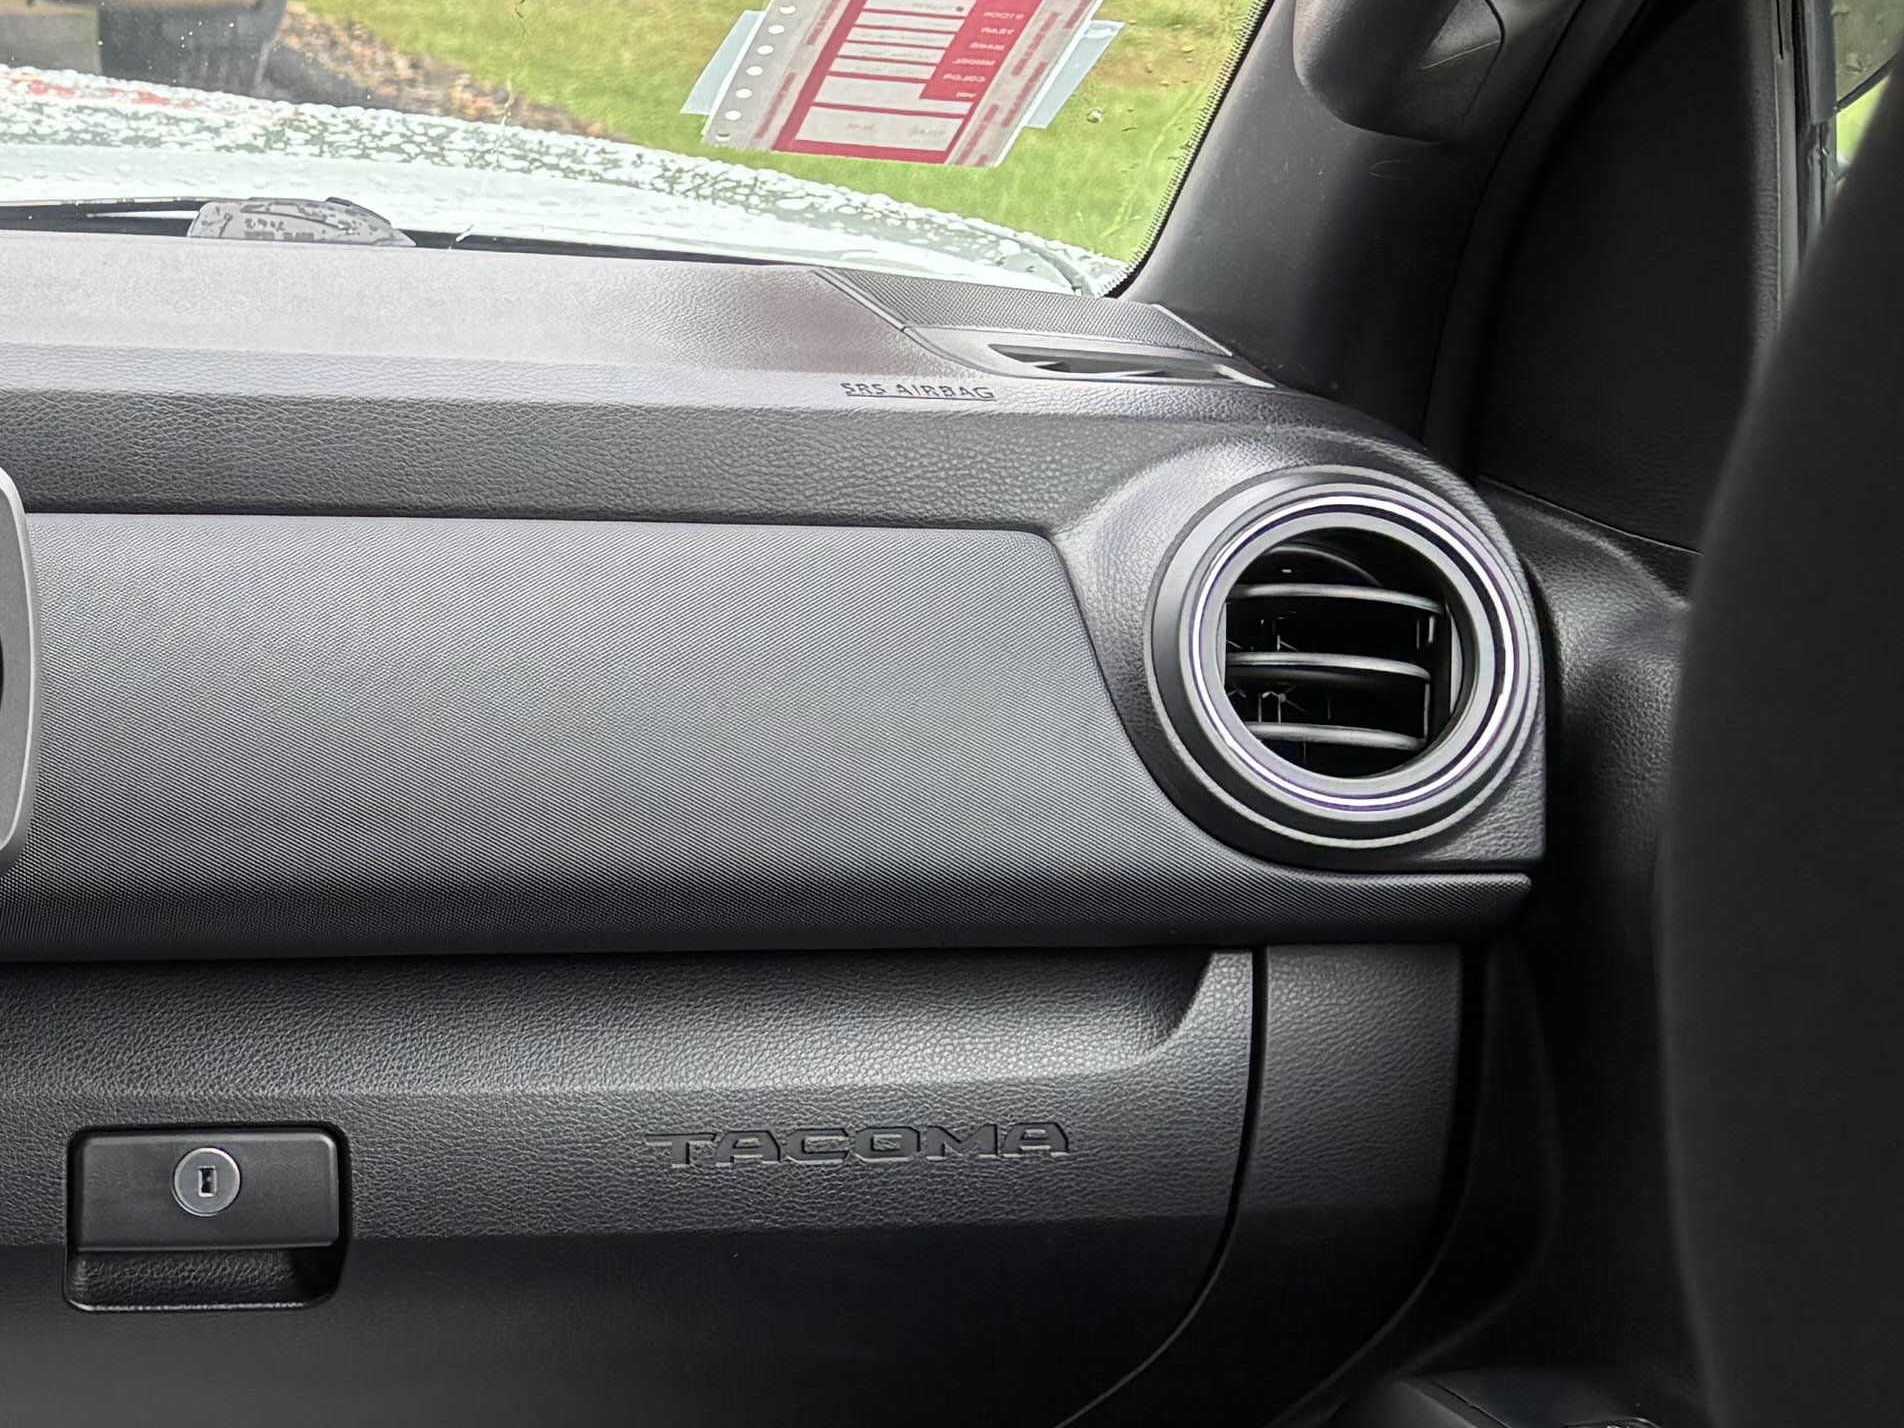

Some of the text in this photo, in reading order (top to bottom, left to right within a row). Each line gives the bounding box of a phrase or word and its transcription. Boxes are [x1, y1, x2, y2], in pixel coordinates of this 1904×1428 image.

[840, 381, 886, 397] SRS
[895, 383, 995, 400] AIRBAG
[644, 1120, 1071, 1168] TACOMA
